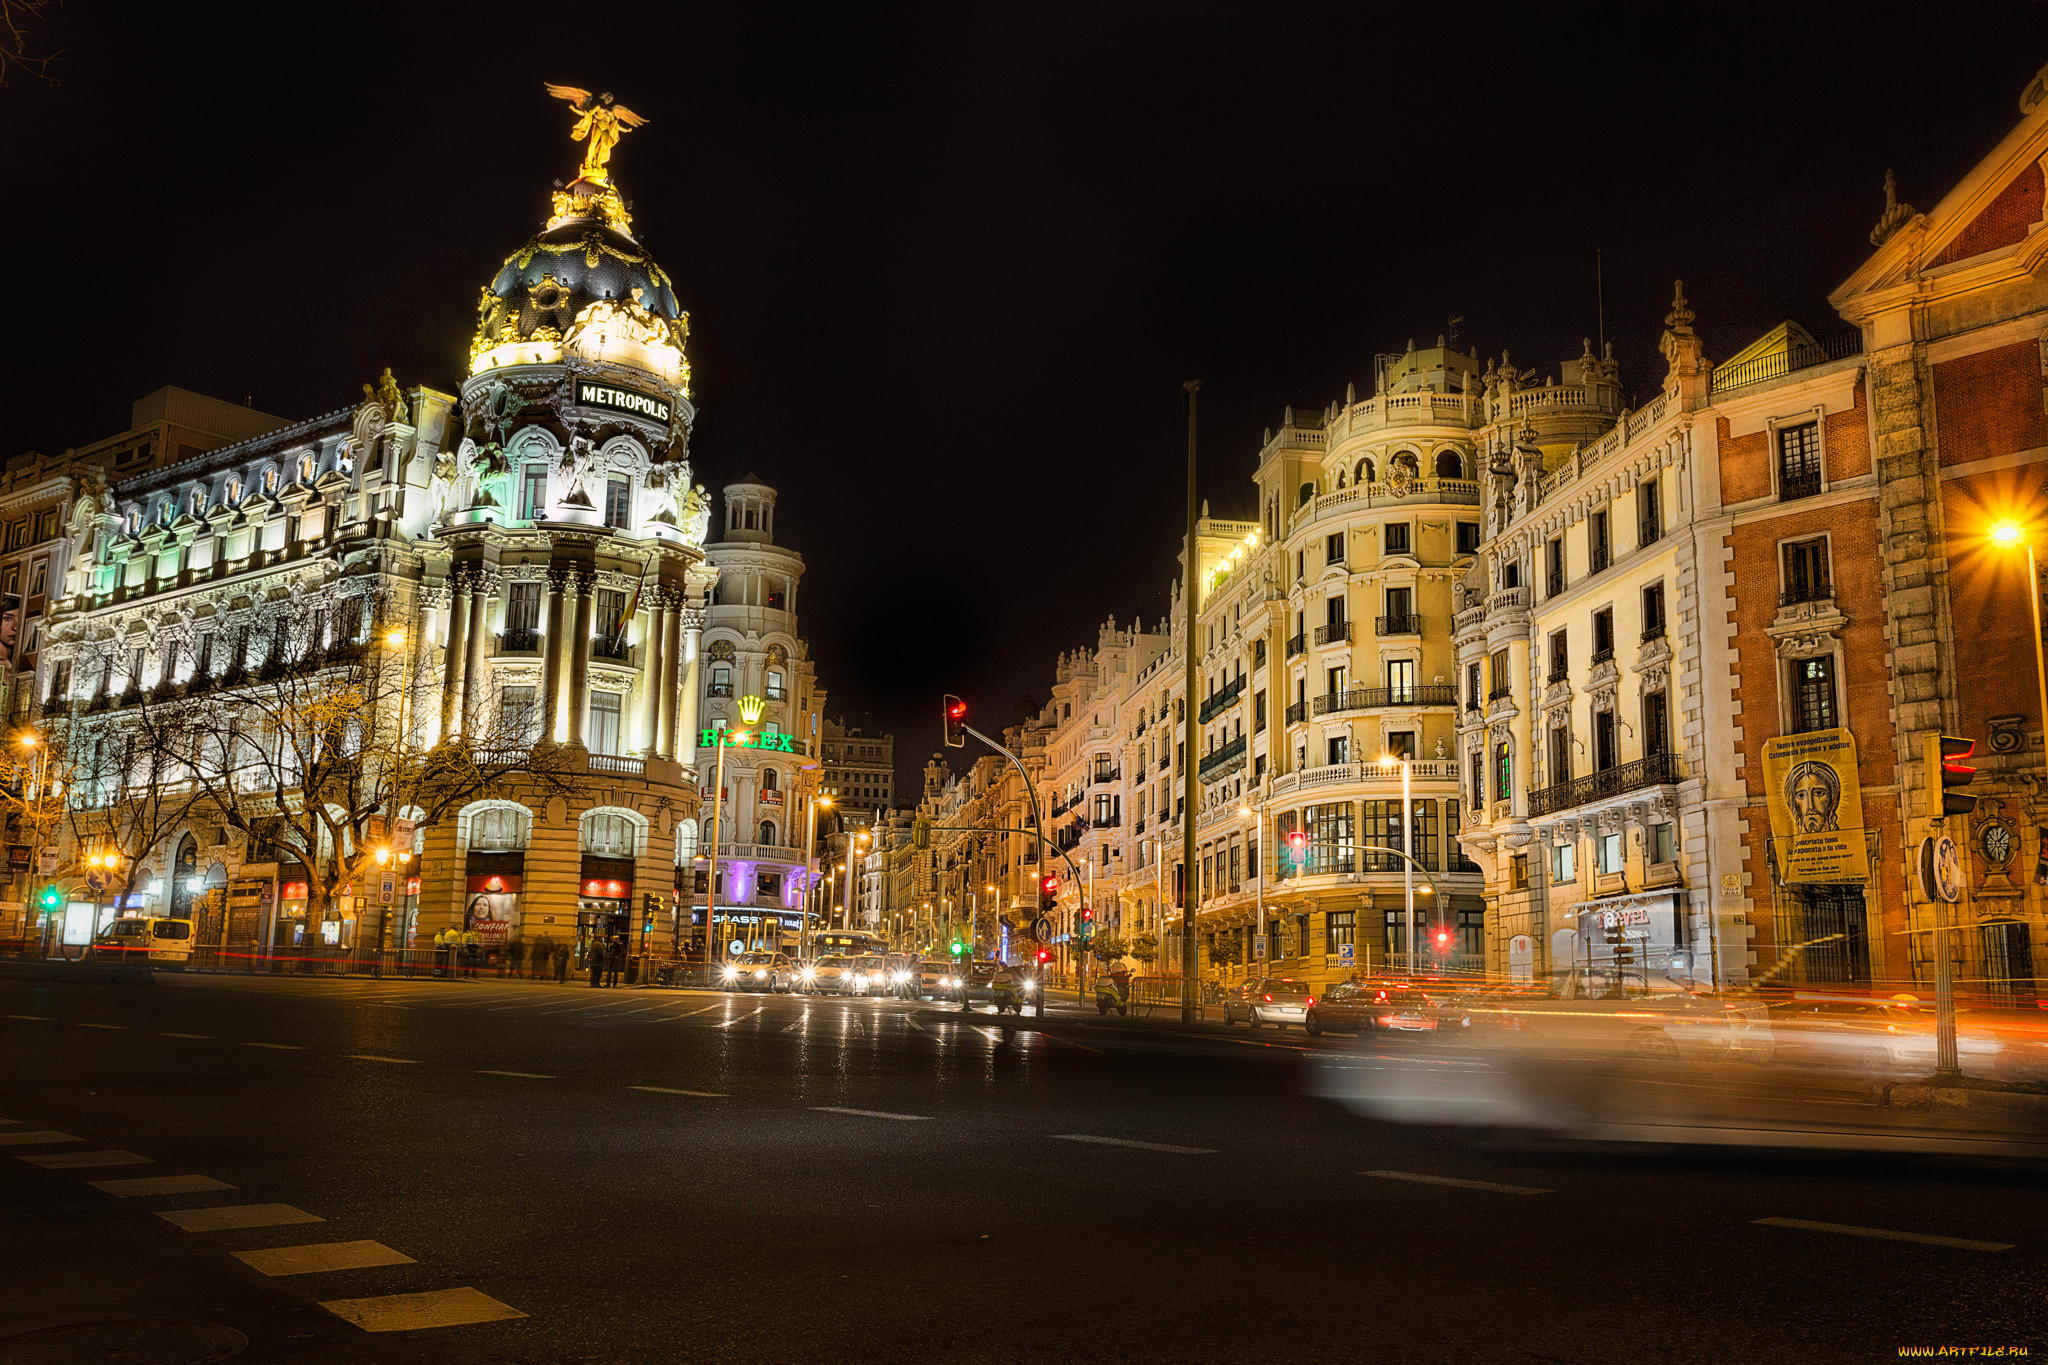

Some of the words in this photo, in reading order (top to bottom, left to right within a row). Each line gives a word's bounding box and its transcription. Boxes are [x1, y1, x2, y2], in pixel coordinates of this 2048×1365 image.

[582, 386, 668, 420] METROPOLIS
[700, 728, 793, 752] ROLEX
[1776, 741, 1795, 750] Nueva
[1796, 734, 1840, 747] evangelización
[1768, 749, 1799, 760] Catequesis
[1828, 742, 1850, 751] adultos
[1824, 836, 1838, 844] tiene
[1834, 843, 1847, 851] vida
[712, 915, 761, 924] GRASS
